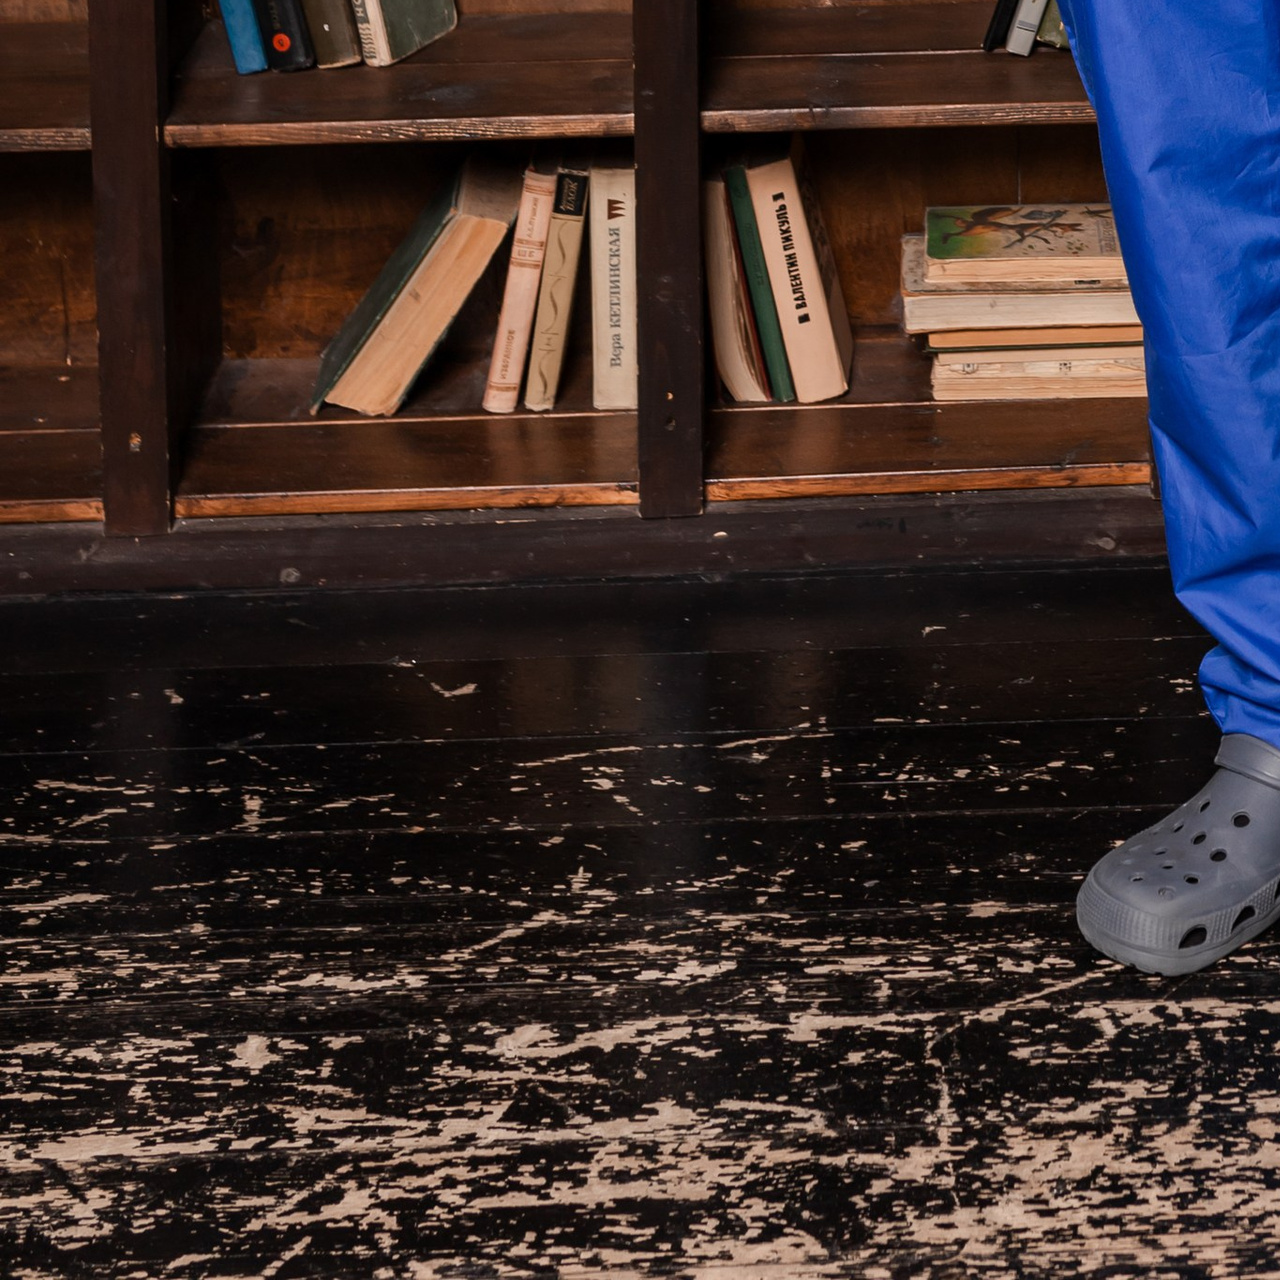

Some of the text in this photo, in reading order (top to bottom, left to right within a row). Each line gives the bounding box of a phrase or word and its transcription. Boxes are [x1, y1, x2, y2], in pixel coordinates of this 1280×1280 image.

[564, 178, 579, 210] БЛОК
[774, 202, 808, 310] ВАЛЕНТИН ПИКУЛЬ
[608, 226, 624, 367] Вера КЕТЛИНСКАЯ
[498, 327, 515, 380] ИЗБРАННОЕ
